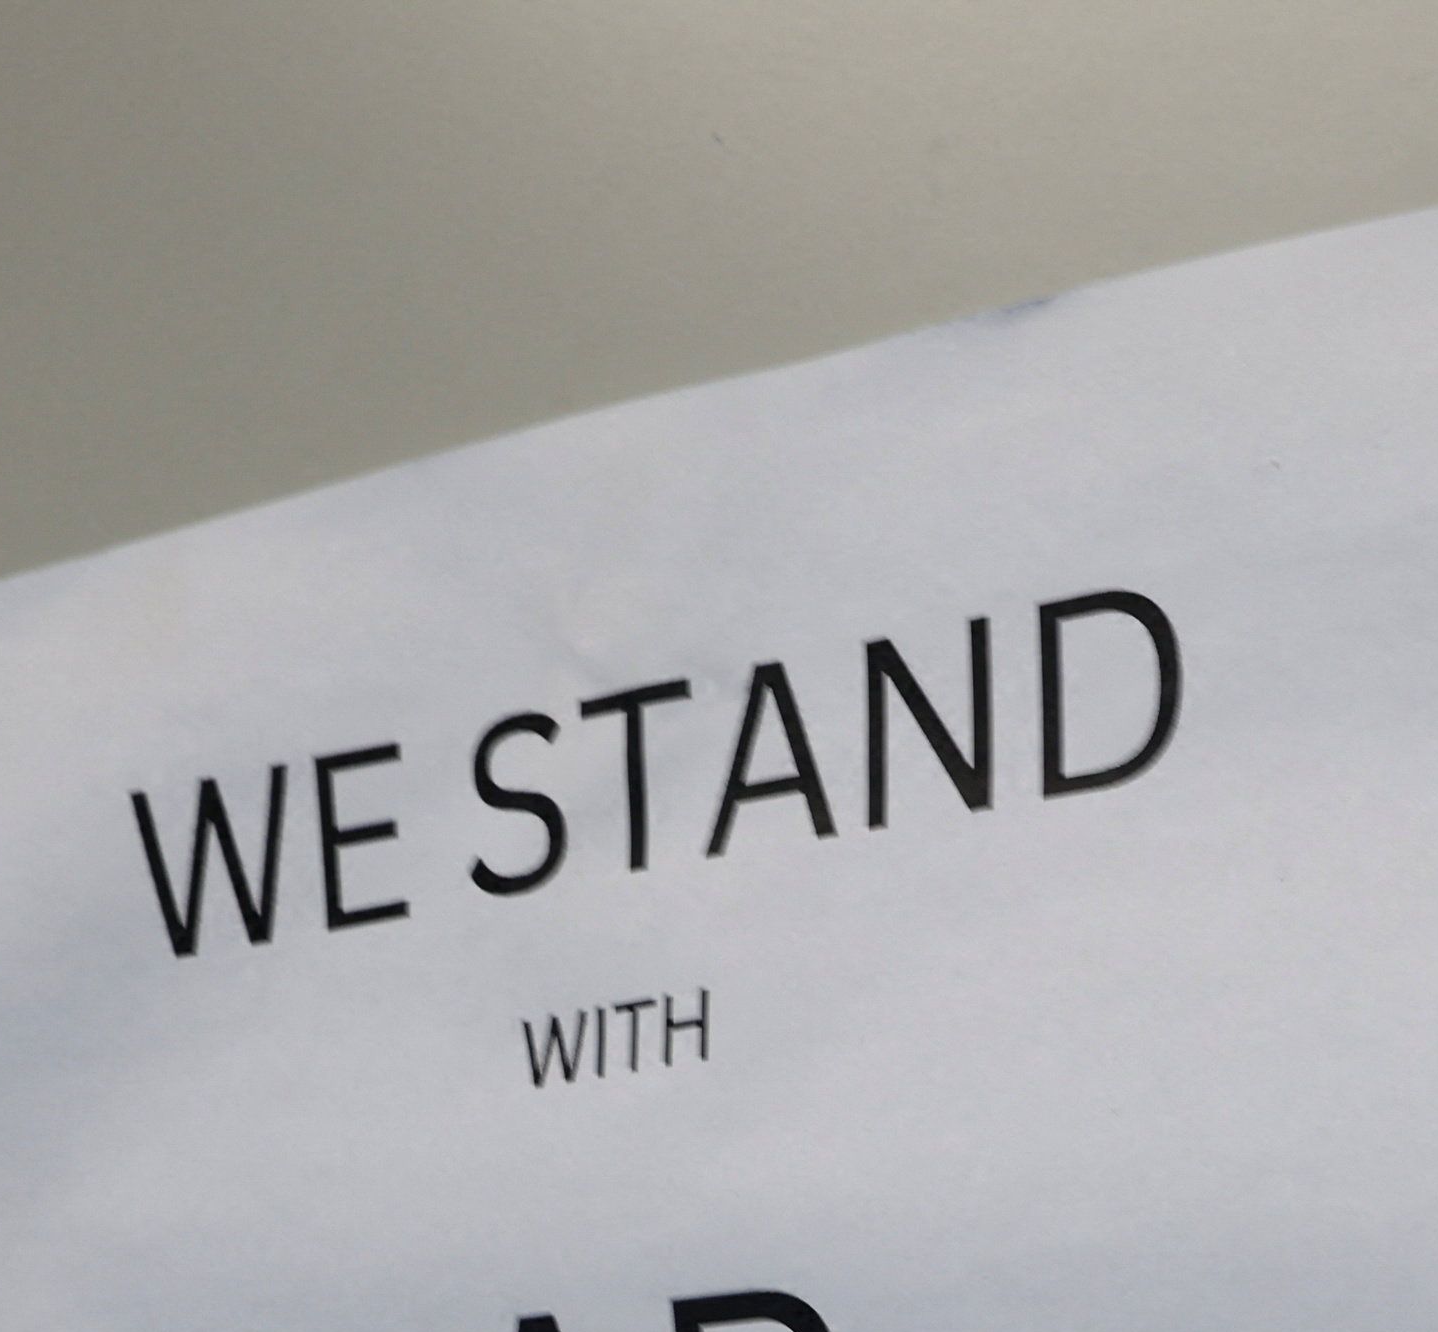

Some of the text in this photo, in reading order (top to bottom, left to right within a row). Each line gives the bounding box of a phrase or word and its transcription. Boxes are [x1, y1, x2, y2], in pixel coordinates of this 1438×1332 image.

[129, 589, 1183, 959] WE STAND
[522, 988, 709, 1088] WITH
